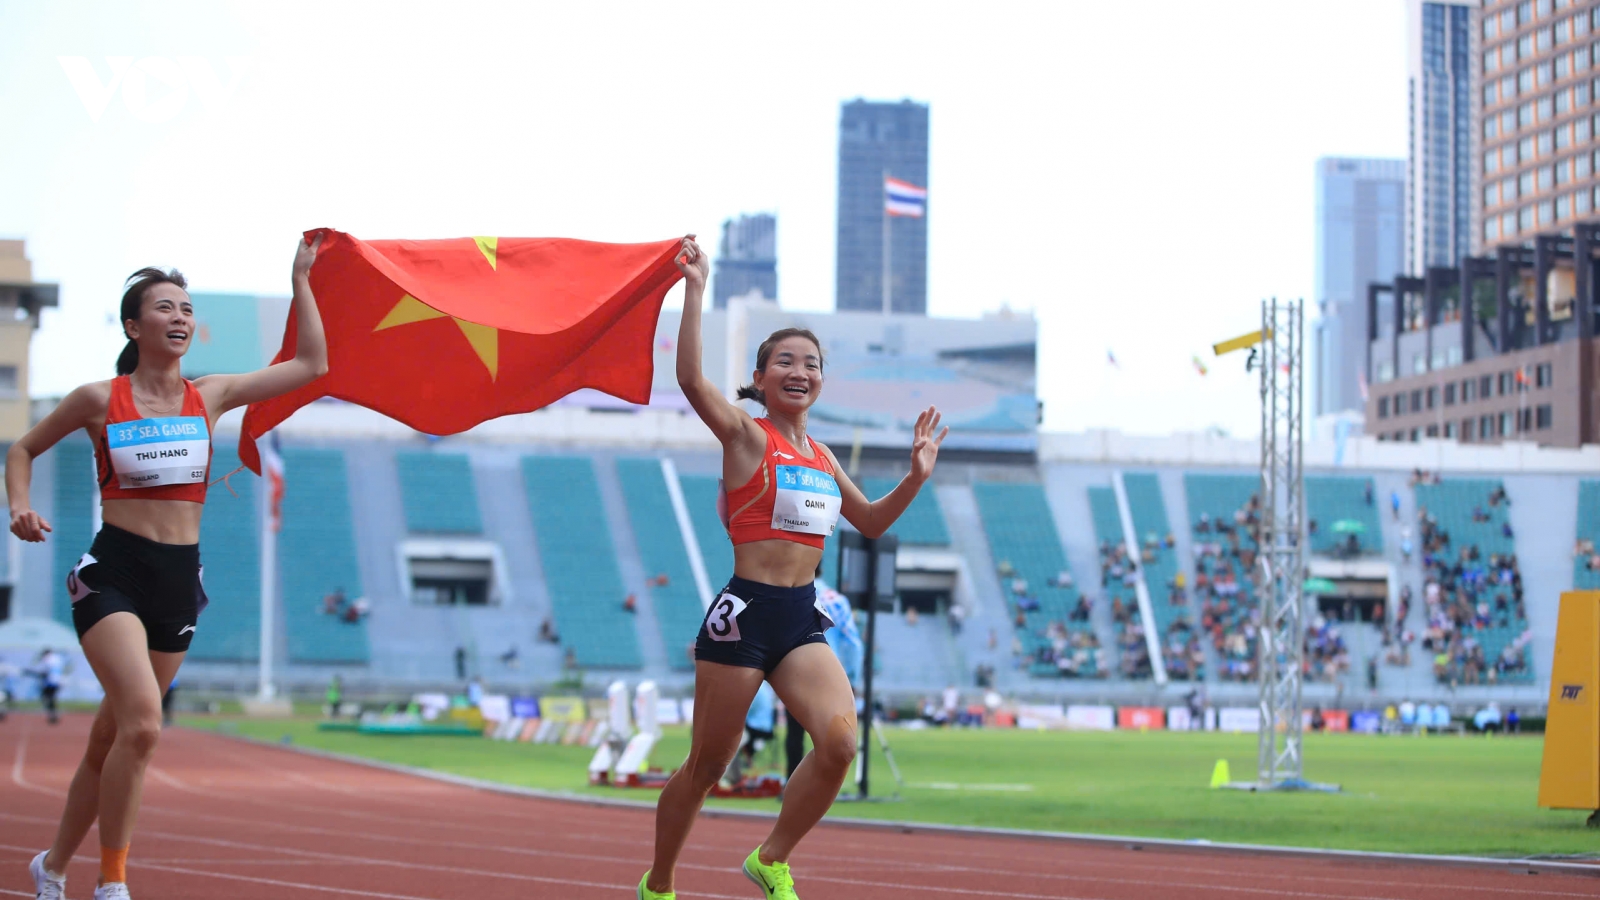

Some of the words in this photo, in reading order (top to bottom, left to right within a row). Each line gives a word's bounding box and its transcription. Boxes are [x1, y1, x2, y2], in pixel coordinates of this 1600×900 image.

[139, 426, 160, 438] SEA
[162, 424, 197, 436] GAMES
[136, 450, 157, 460] THU
[160, 448, 188, 459] HANG
[802, 475, 814, 486] SEA
[816, 477, 834, 490] GAMES
[805, 500, 825, 509] OANH
[710, 599, 734, 637] 3
